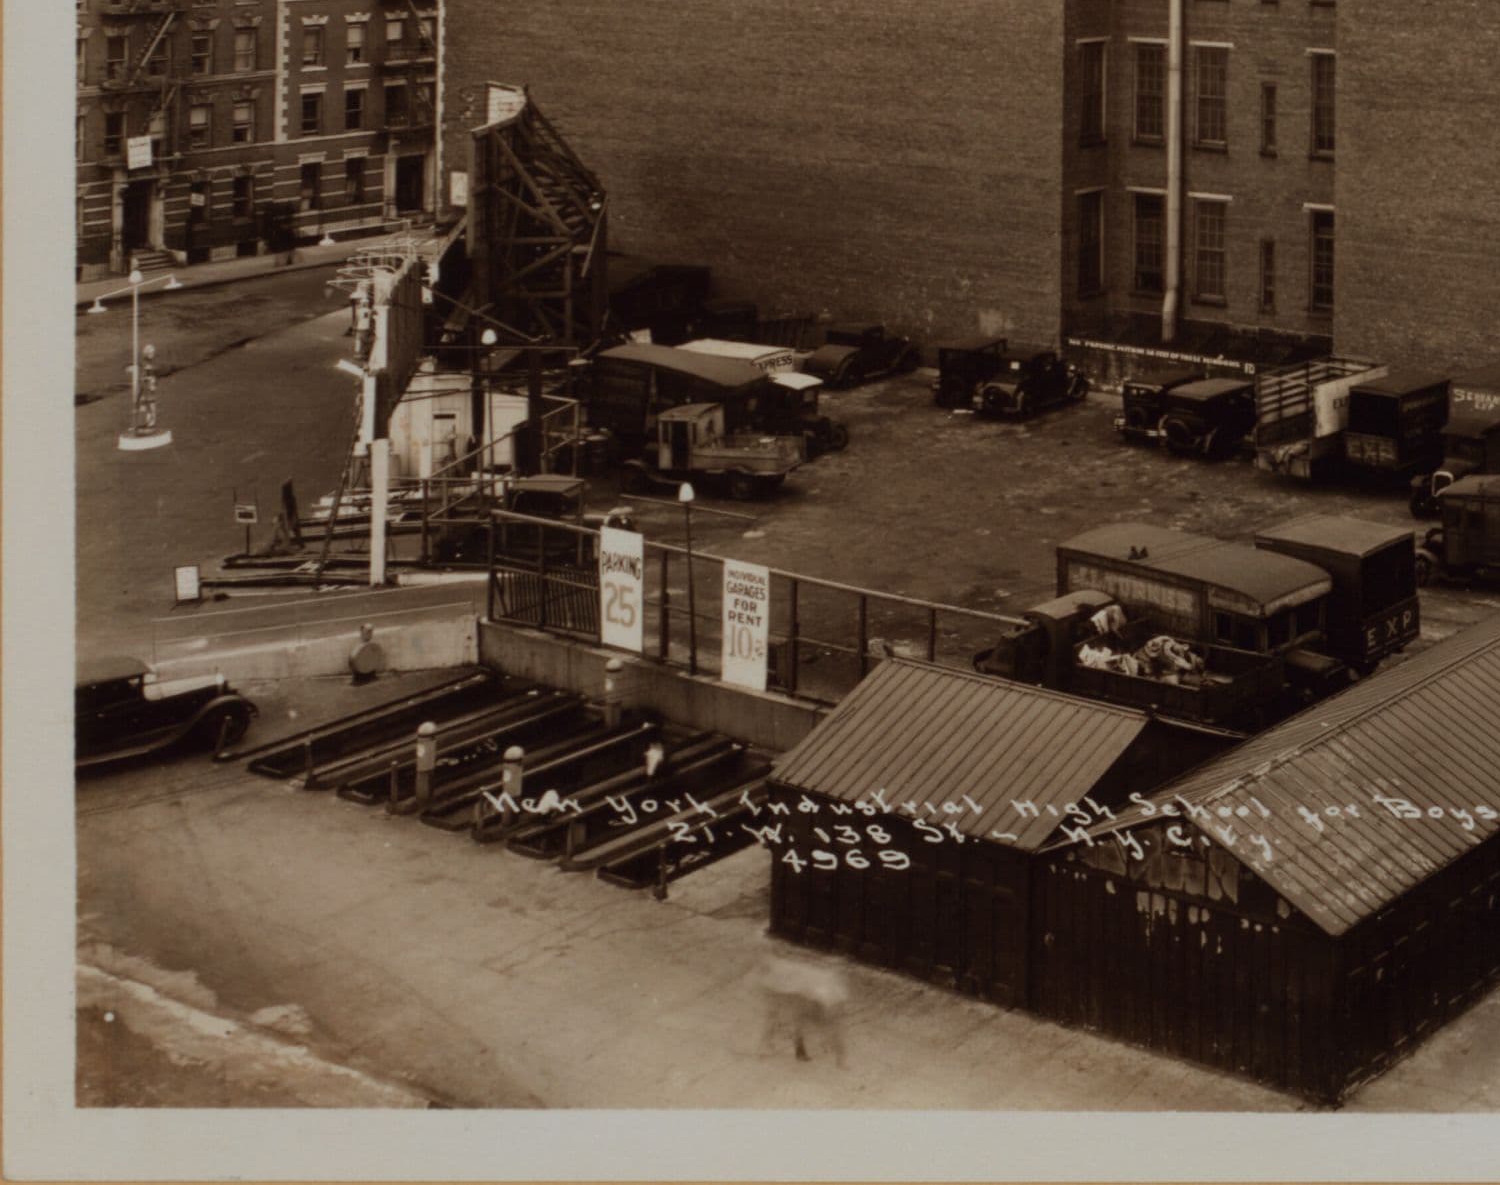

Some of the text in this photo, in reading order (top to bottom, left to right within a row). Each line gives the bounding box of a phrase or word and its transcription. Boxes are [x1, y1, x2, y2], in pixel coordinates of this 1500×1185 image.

[601, 551, 642, 581] PARKING
[726, 581, 767, 601] GARAGES
[733, 598, 758, 614] FOR
[727, 610, 763, 628] RENT
[1366, 610, 1412, 648] EXP
